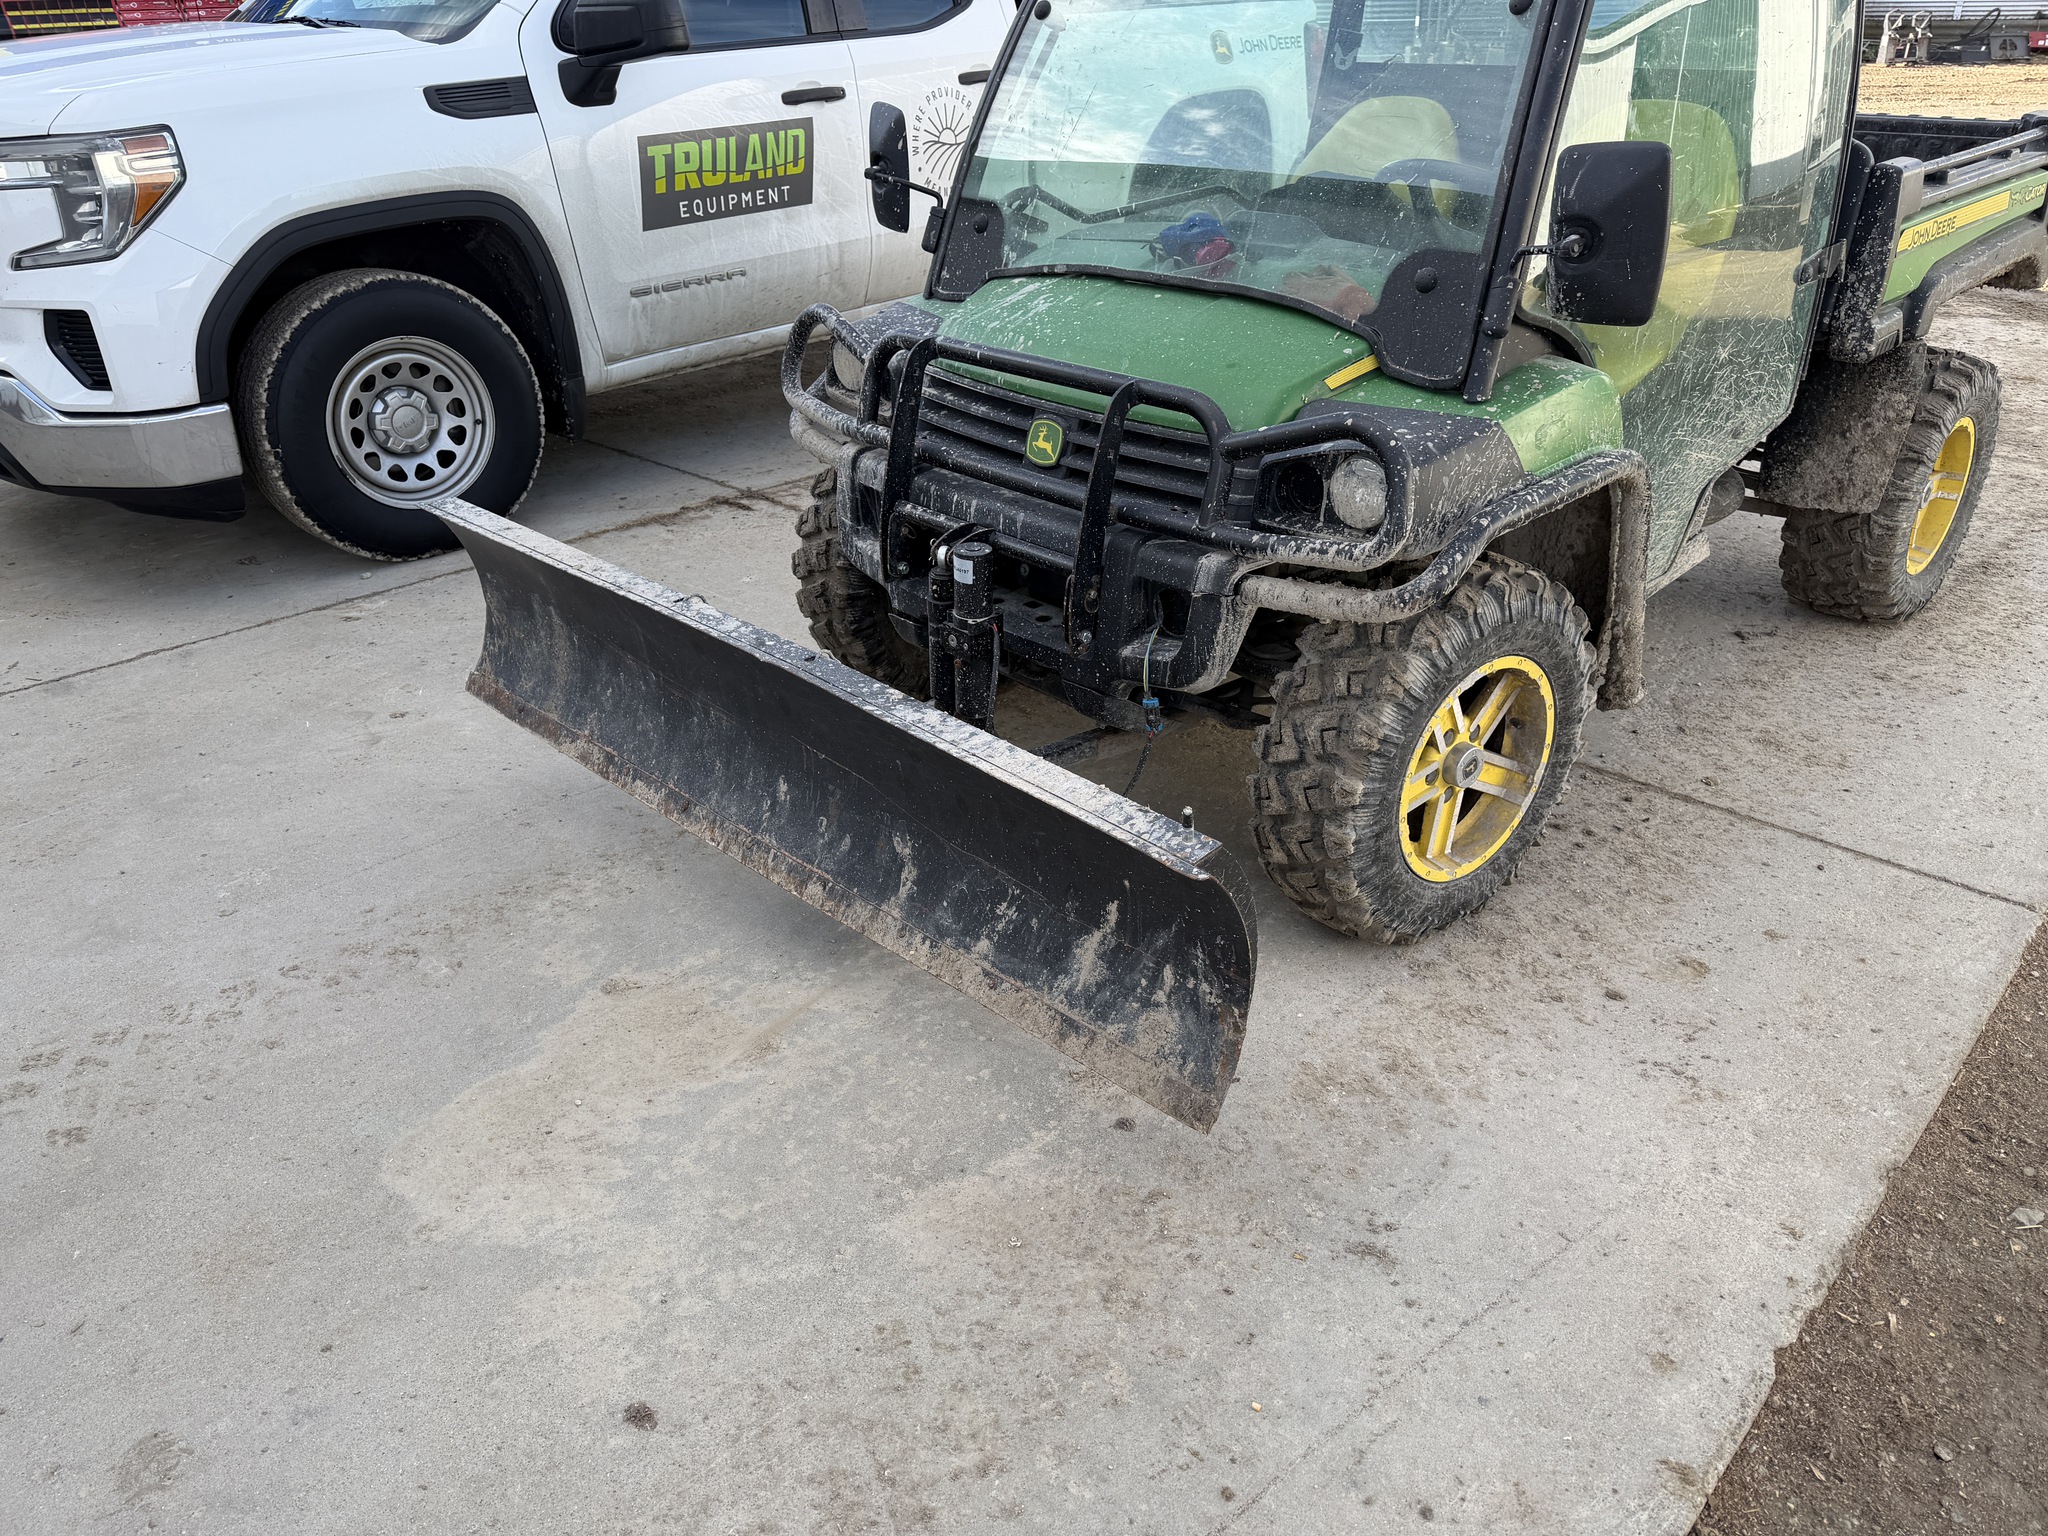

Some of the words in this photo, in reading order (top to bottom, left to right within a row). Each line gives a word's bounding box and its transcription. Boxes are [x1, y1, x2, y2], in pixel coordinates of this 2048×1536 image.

[1239, 37, 1268, 54] JOHN
[1268, 34, 1303, 51] DEERE
[911, 105, 926, 157] WHERE
[925, 86, 973, 111] PROVIDER
[646, 127, 806, 195] TRULAND
[679, 185, 791, 219] EQUIPMENT
[923, 176, 950, 198] MEAN
[1907, 228, 1931, 248] JOHN
[1931, 215, 1957, 239] DEERE
[629, 266, 748, 299] SIERRA
